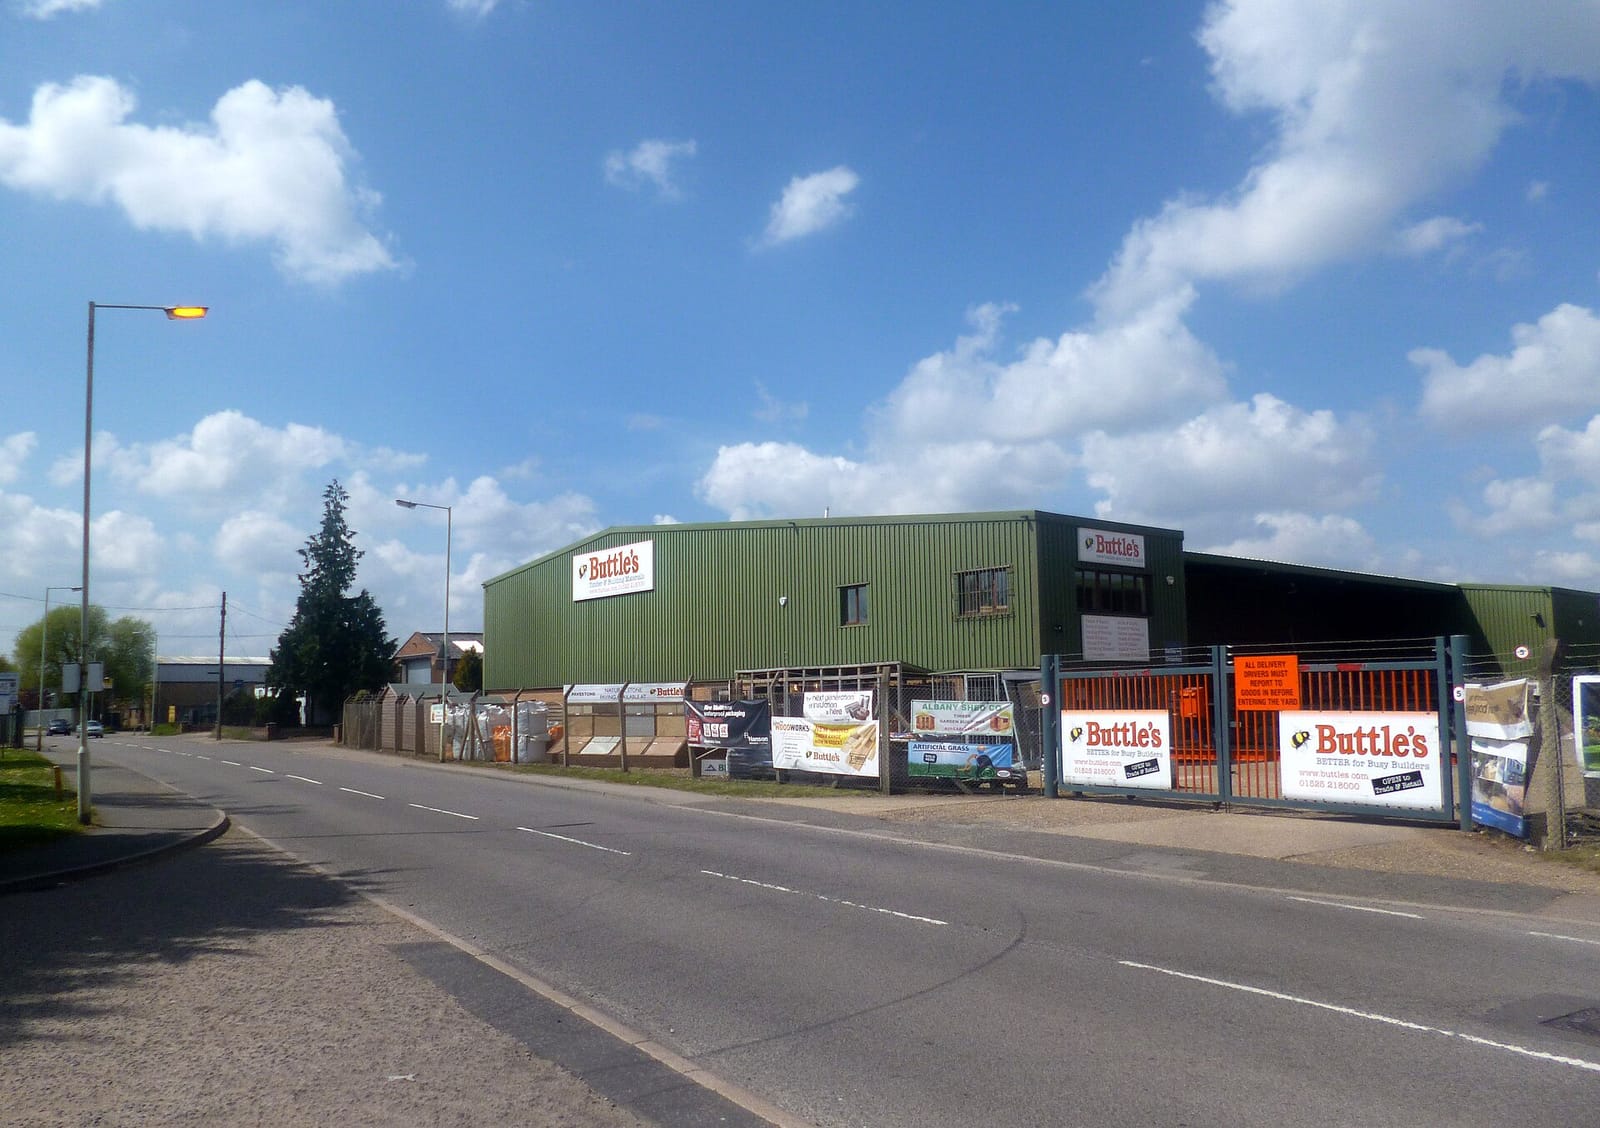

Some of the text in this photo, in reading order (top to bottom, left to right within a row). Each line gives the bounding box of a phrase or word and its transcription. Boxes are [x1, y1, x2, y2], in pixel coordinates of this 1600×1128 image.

[1095, 534, 1139, 558] Buttle's
[589, 548, 639, 580] Buttle's
[1245, 660, 1286, 669] ALL DELIVERY
[1243, 670, 1288, 678] DRIVERS MUST
[1249, 679, 1283, 687] REPORT TO
[1240, 689, 1261, 697] GOODS
[1270, 688, 1294, 697] BEFORE
[922, 703, 958, 711] ALBANY
[961, 703, 985, 711] SHED
[1238, 698, 1298, 706] ENTERING THE YARD
[775, 722, 810, 732] WOODWORKS
[1086, 721, 1162, 748] Buttle's
[1315, 724, 1429, 759] Buttle's
[913, 743, 970, 752] ARTIFICIAL GRASS
[813, 751, 840, 762] Buttle's
[1086, 748, 1110, 756] BETTER
[1121, 749, 1136, 758] Busy
[1137, 750, 1163, 758] Builders
[1316, 757, 1430, 770] BETTER for Busy Builders
[1299, 779, 1360, 790] 01525 218000
[1382, 776, 1402, 785] OPEN
[1374, 785, 1394, 794] Trade
[1401, 779, 1422, 789] Retail
